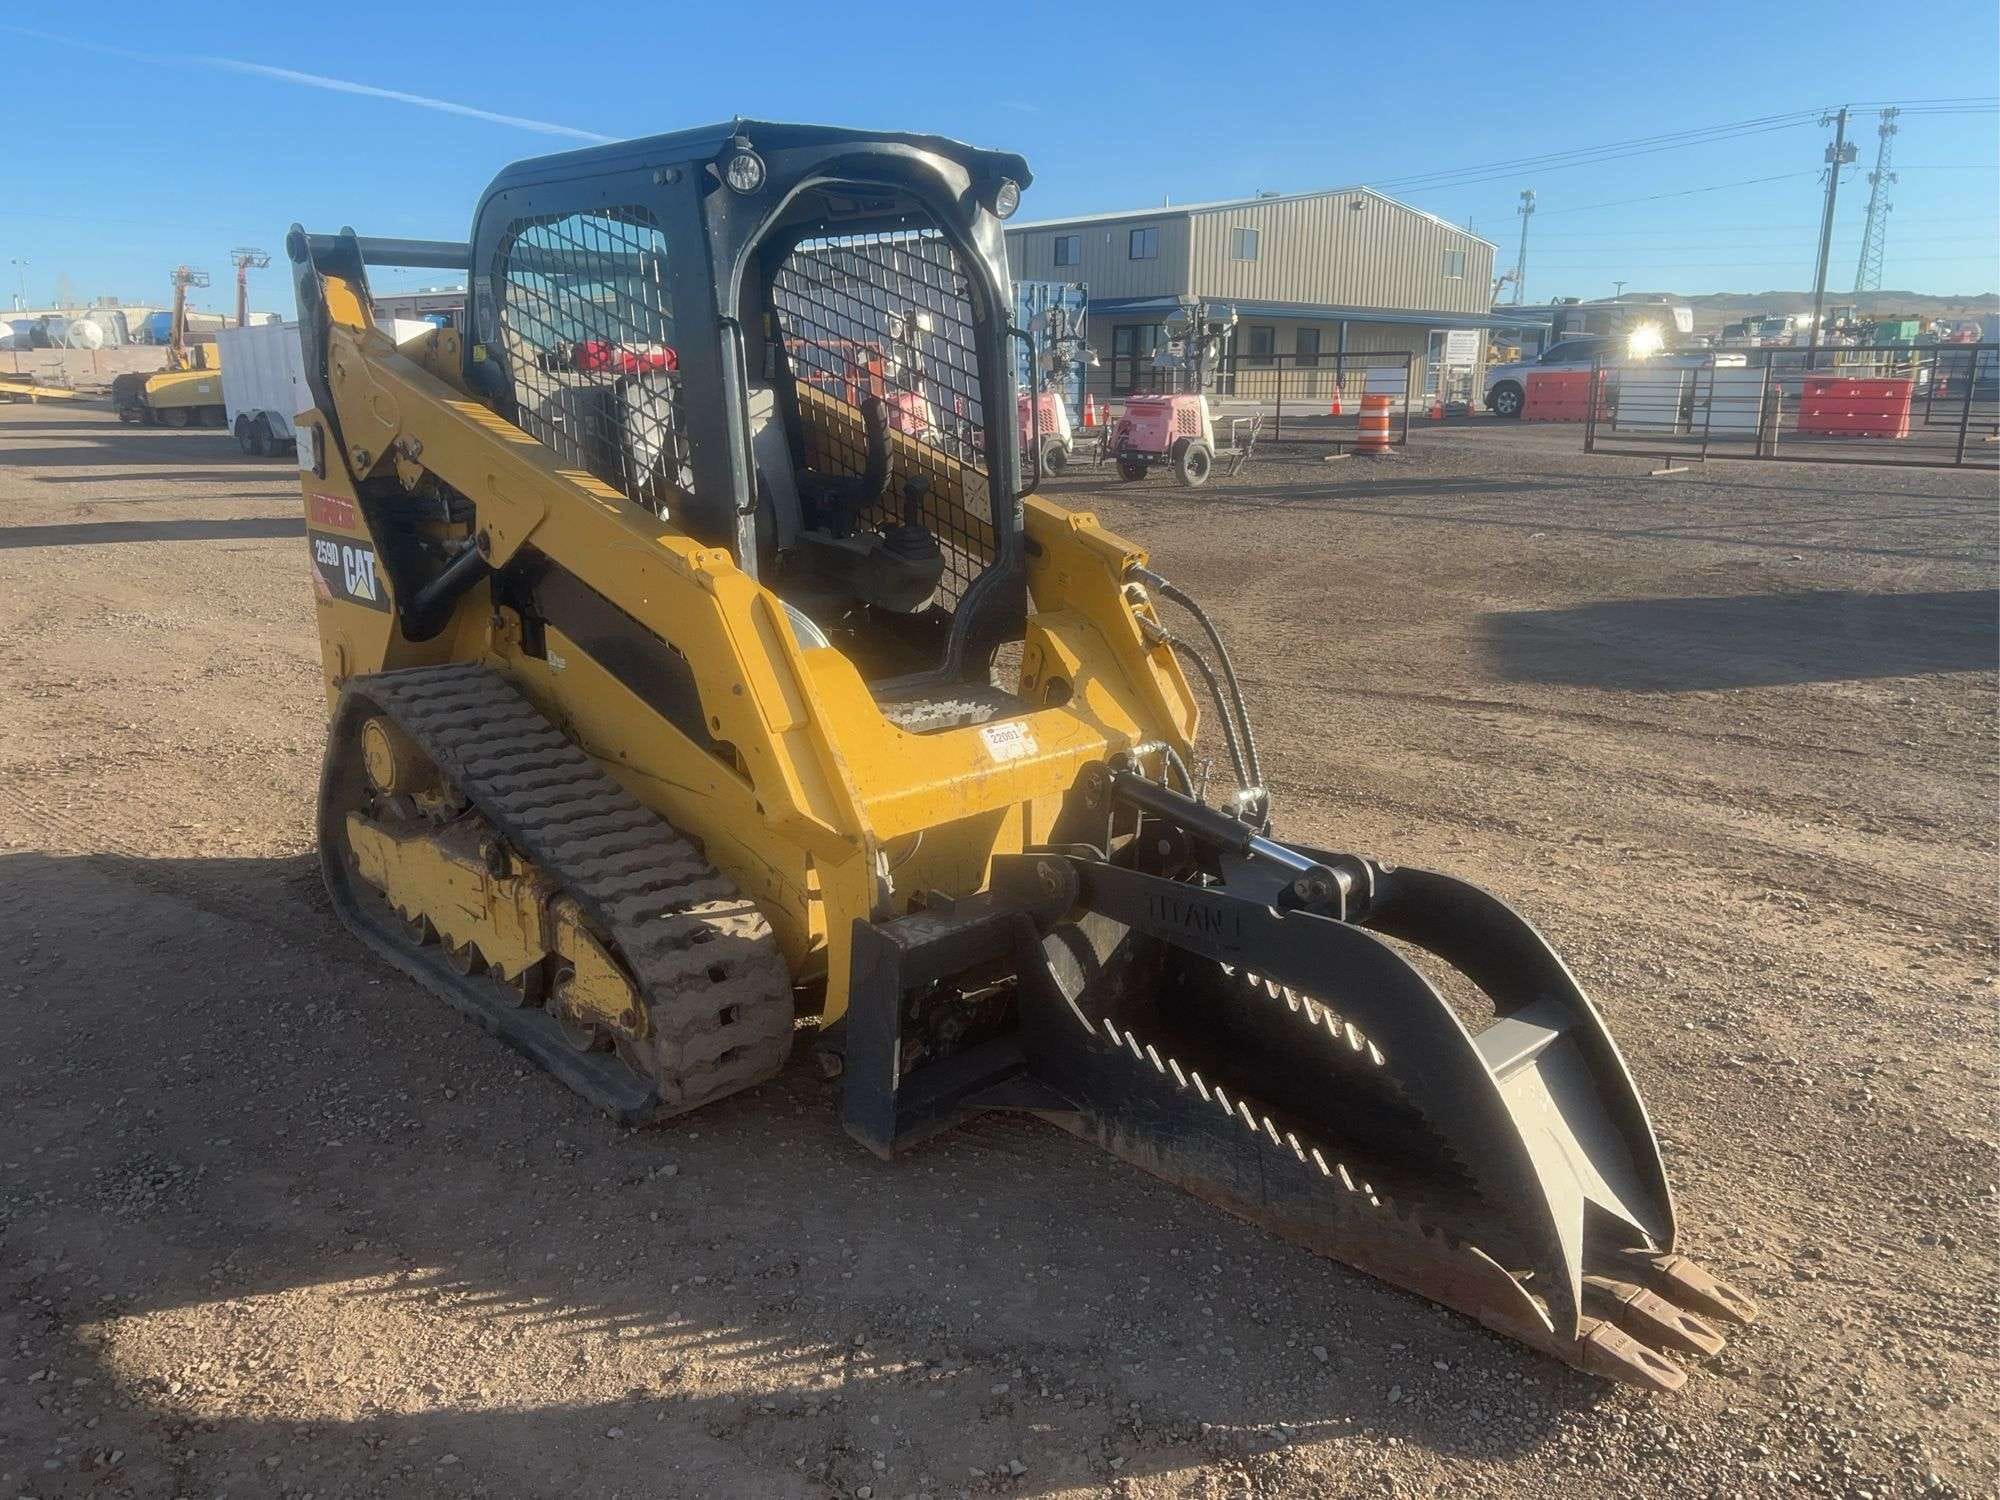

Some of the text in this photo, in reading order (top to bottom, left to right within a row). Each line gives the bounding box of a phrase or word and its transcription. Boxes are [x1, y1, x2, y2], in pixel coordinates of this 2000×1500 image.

[315, 540, 376, 601] 259D CAT
[990, 730, 1019, 743] 22001
